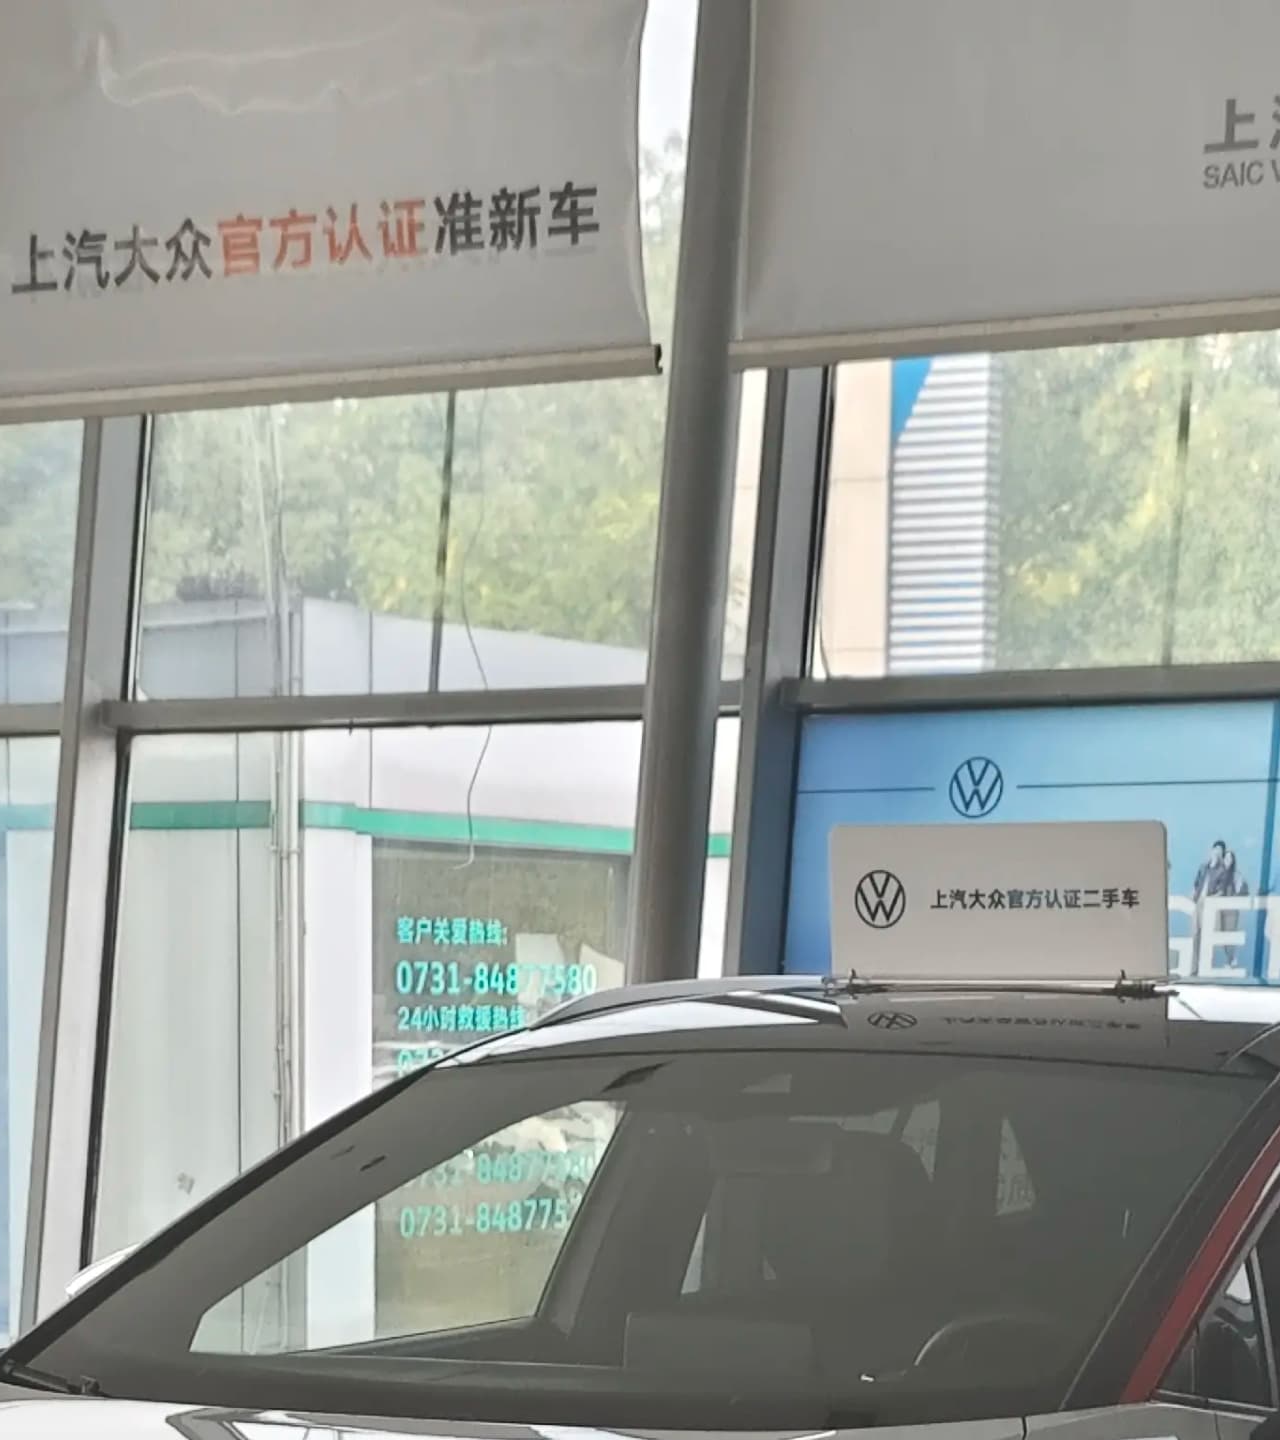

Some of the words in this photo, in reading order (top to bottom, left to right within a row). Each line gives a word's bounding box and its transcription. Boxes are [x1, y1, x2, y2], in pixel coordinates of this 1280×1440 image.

[1203, 161, 1264, 189] SAIC
[12, 181, 600, 295] 上汽大众官方认证准新车
[930, 888, 1140, 911] 上汽大众官方认证二手车
[396, 960, 597, 996] 0731-84877580
